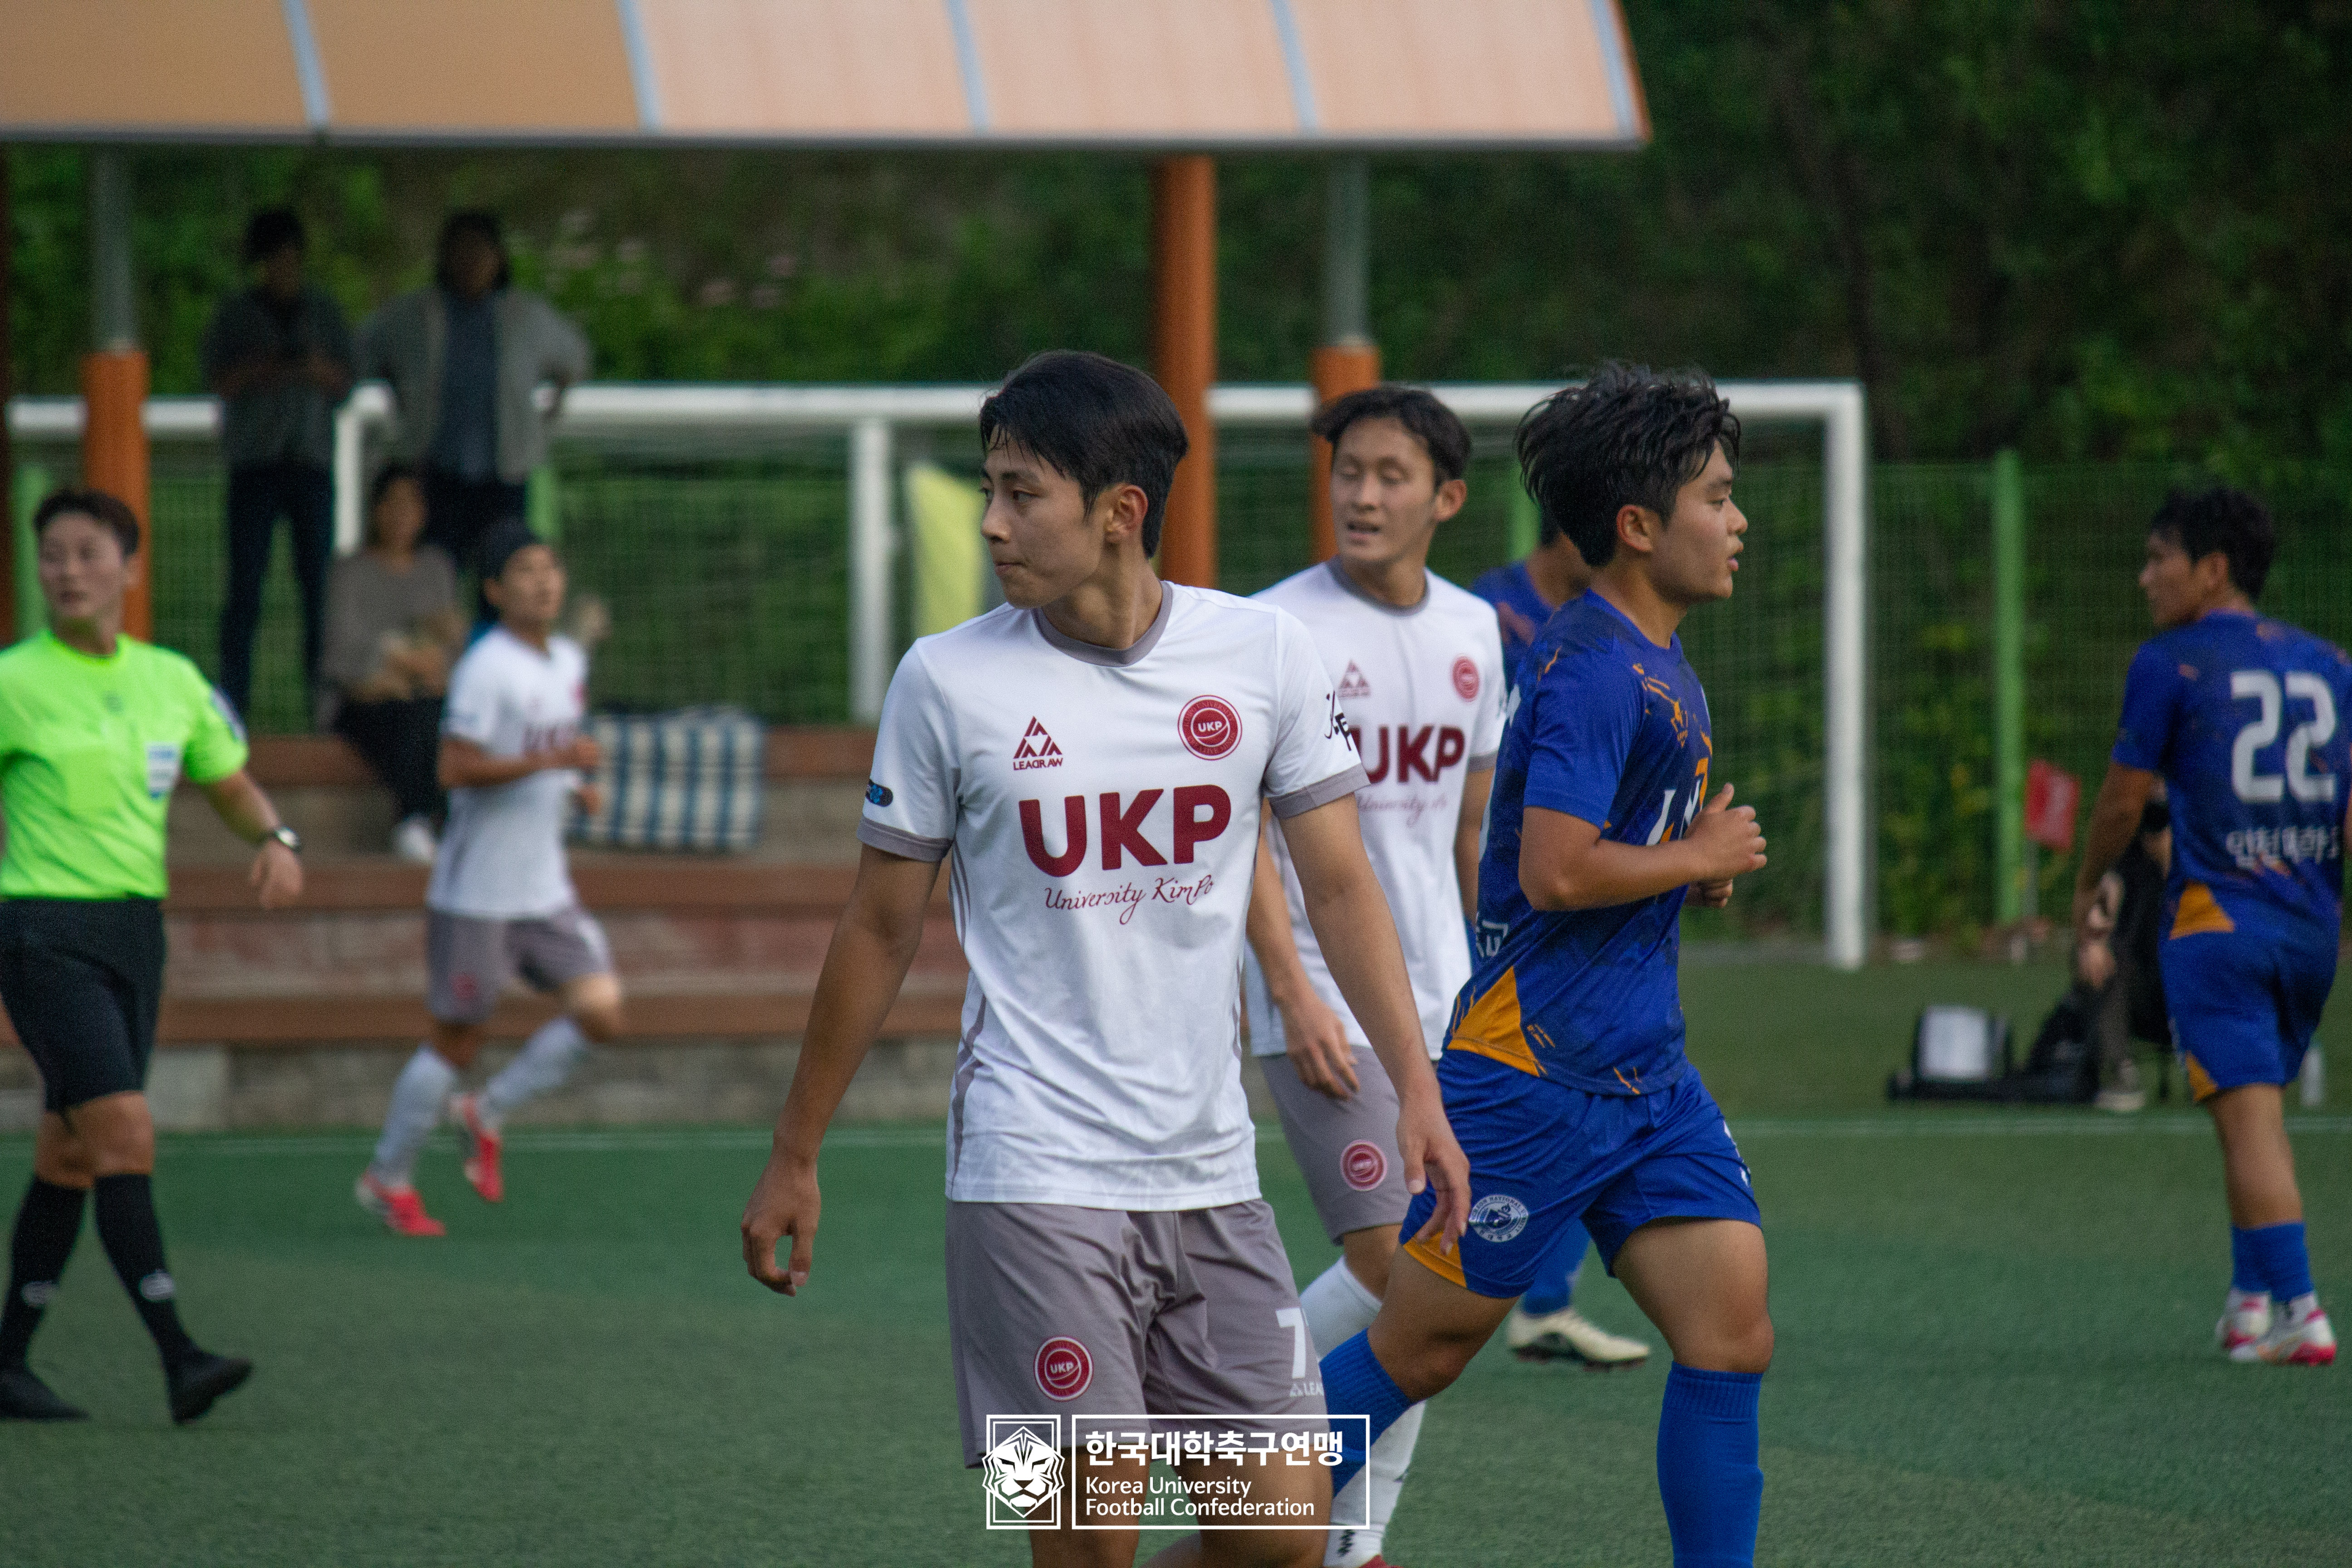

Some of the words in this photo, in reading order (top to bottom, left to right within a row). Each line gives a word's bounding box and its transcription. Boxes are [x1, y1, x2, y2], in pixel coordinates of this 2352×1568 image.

[1197, 721, 1223, 732] UKP
[2230, 669, 2337, 803] 22
[1349, 724, 1465, 785] UKP
[1019, 784, 1231, 877] UKP
[1044, 882, 1147, 925] University
[1049, 1362, 1074, 1374] UKP
